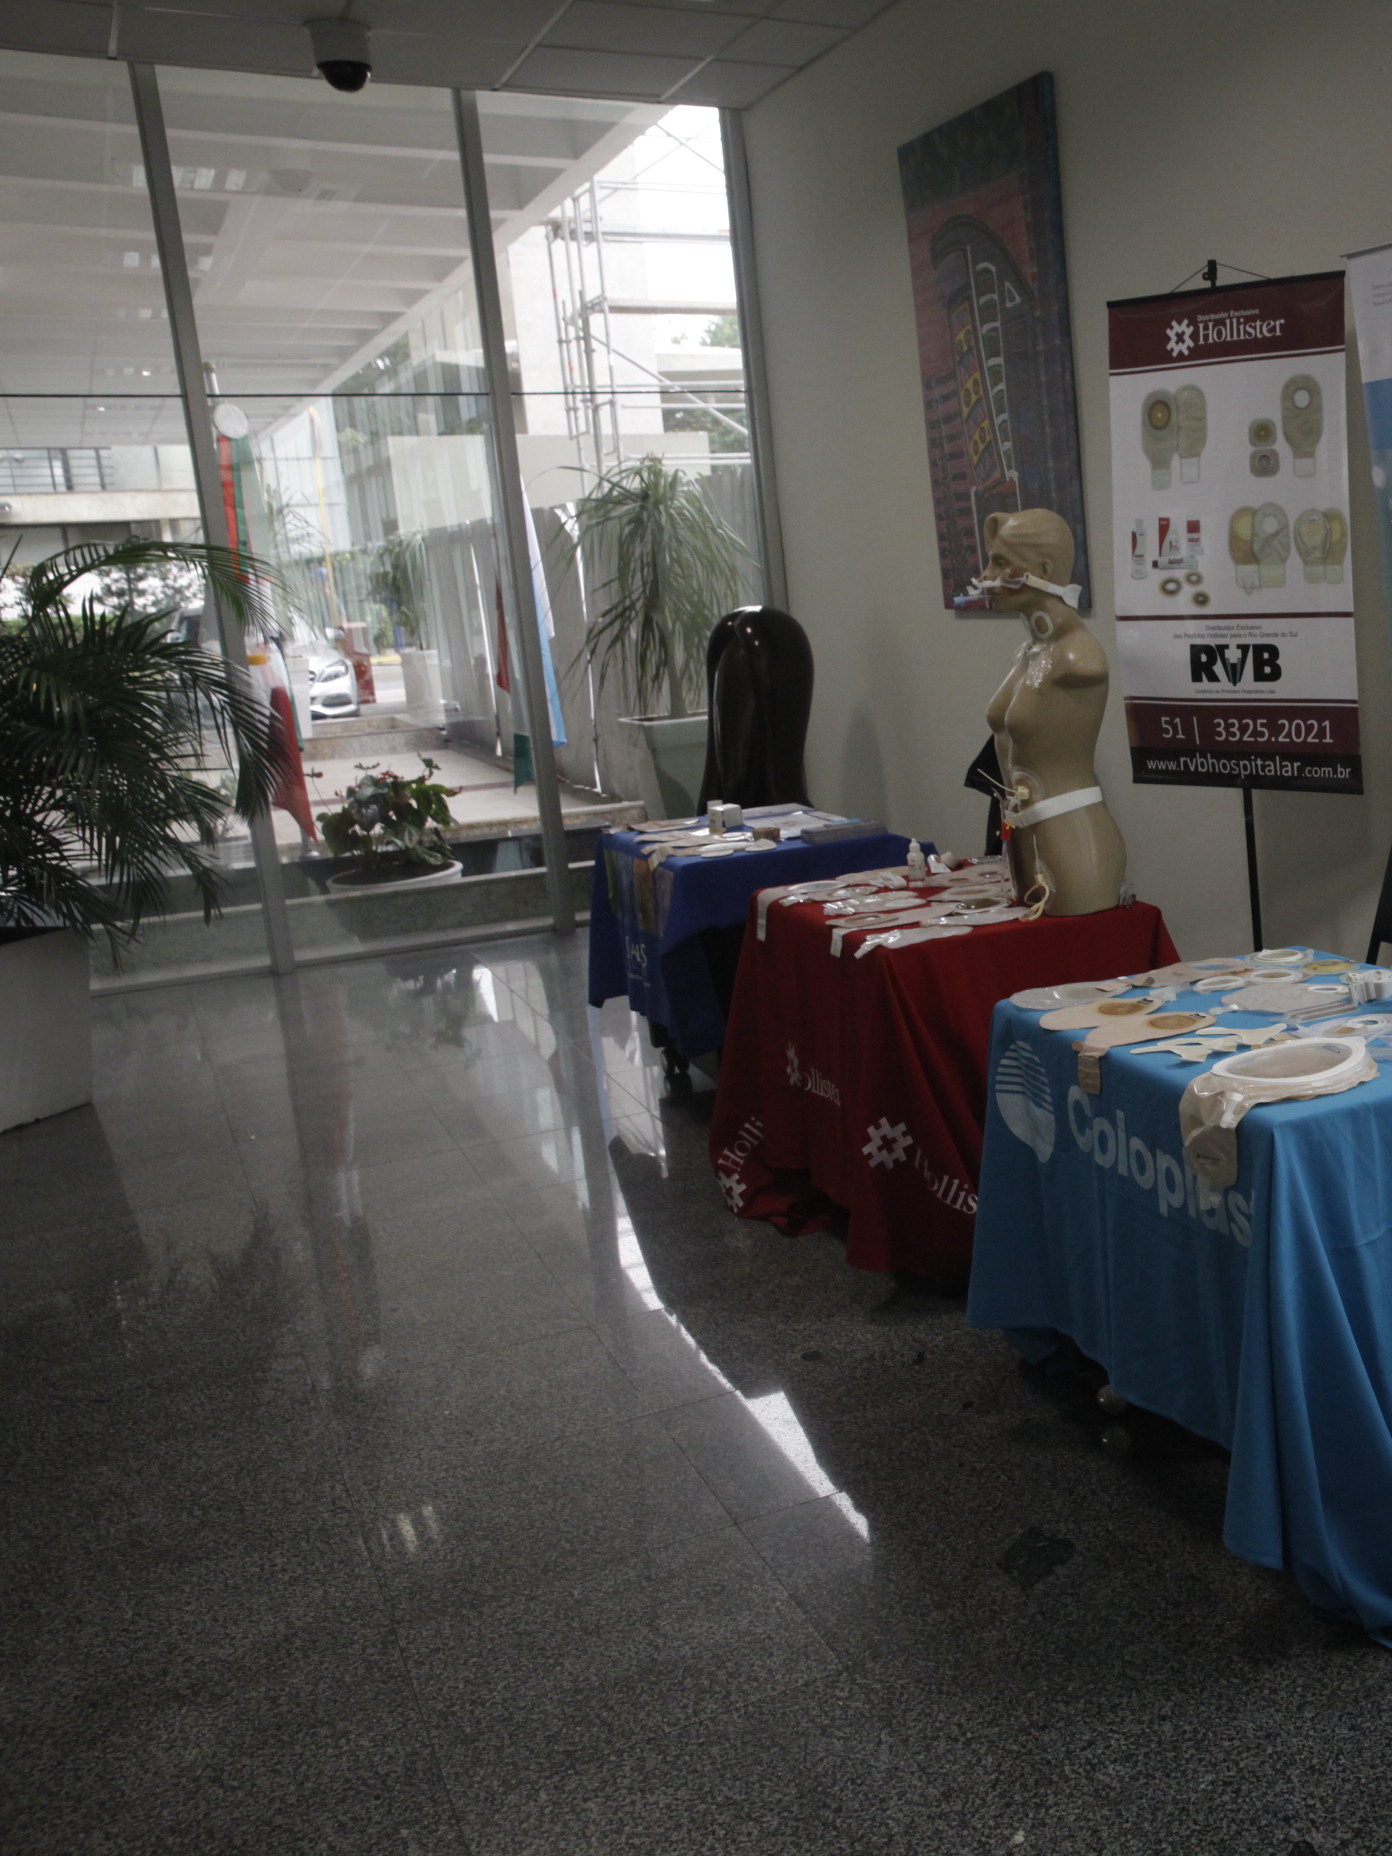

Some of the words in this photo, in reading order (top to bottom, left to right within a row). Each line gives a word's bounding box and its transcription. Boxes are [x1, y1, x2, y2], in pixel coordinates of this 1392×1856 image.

[1198, 317, 1285, 345] Hollister
[1189, 643, 1282, 687] RVB
[1160, 716, 1186, 739] 51
[1213, 718, 1334, 743] 3325.2021
[1146, 752, 1351, 779] www.rvbhospitalar.com.br
[1067, 1084, 1255, 1249] Coloplas
